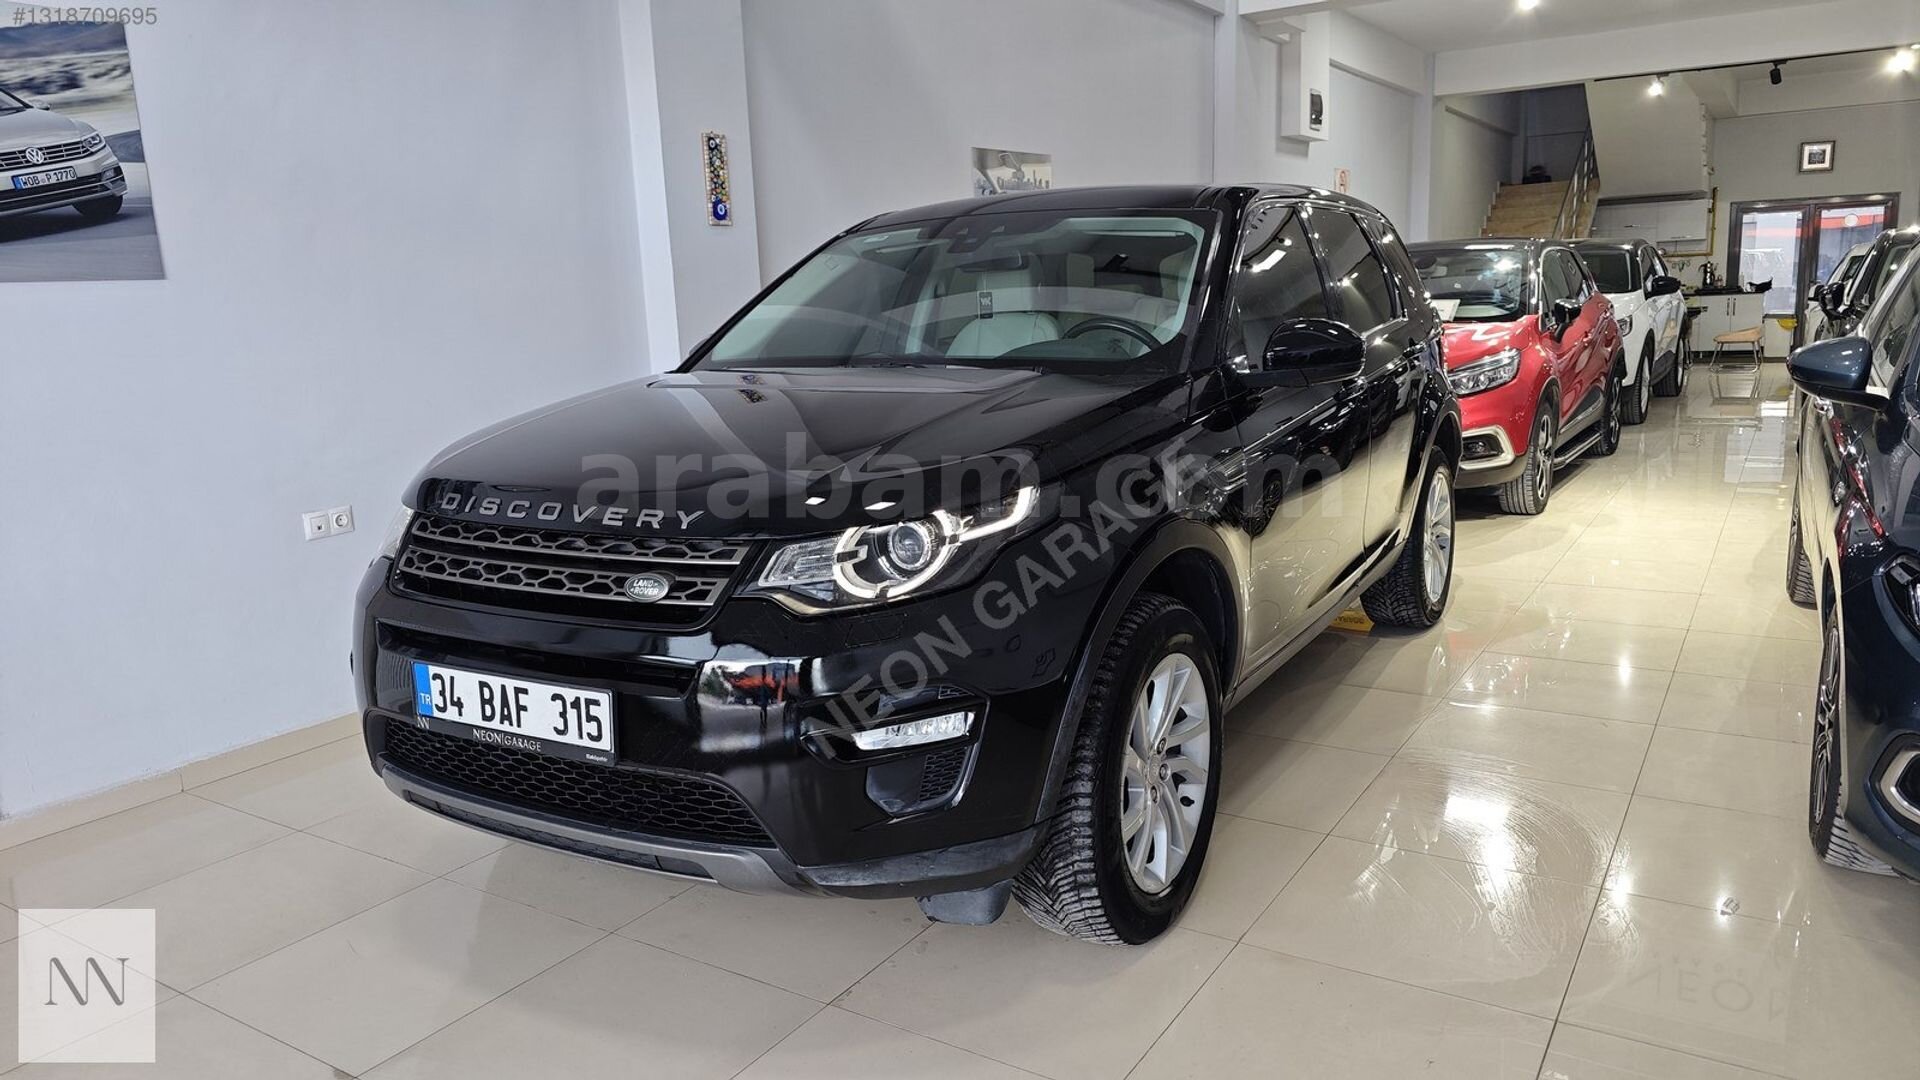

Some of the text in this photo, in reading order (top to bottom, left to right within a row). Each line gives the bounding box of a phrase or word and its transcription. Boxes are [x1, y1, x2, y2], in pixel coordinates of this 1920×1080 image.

[53, 169, 76, 182] 1770
[440, 492, 705, 529] DISCOVERY
[633, 579, 654, 587] LAND
[633, 586, 659, 596] ROVER
[420, 672, 603, 742] TR 34 BAF 315
